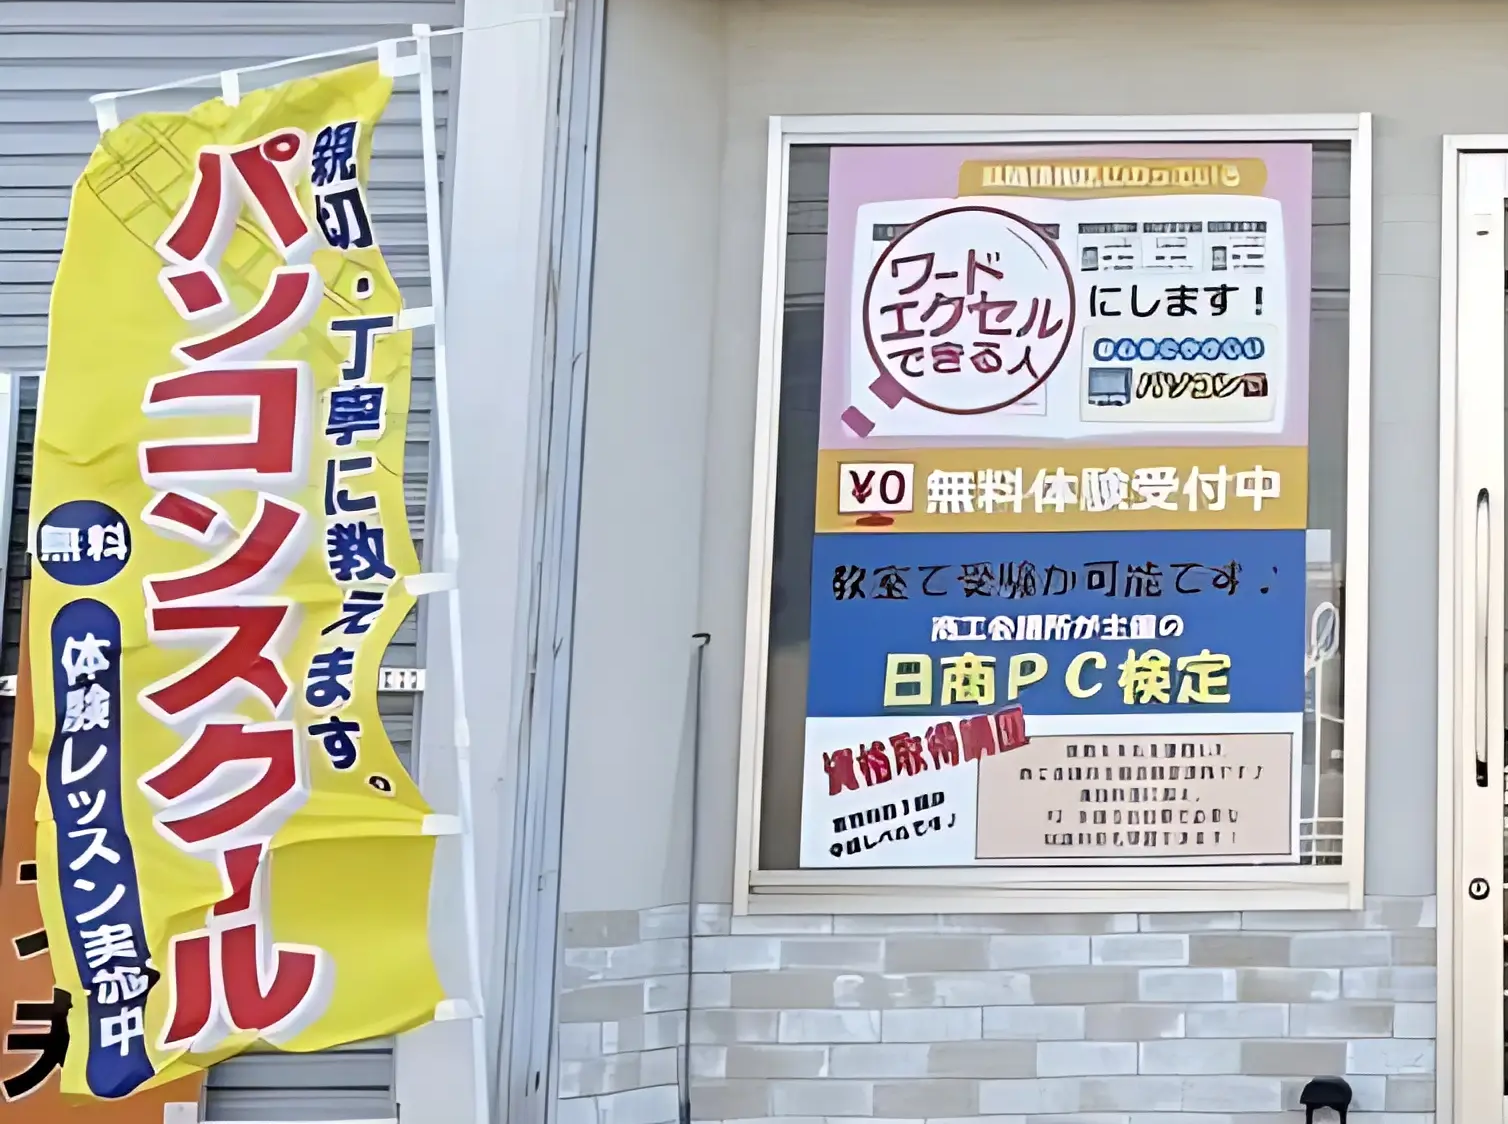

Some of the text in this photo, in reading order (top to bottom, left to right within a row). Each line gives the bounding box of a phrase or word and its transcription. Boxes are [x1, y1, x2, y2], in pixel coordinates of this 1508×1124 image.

[891, 249, 1004, 296] ワード
[880, 291, 1063, 341] エクセル
[888, 340, 1040, 378] できる人
[926, 464, 1282, 514] 無料体験受付中
[141, 129, 321, 1047] パソコンスクール
